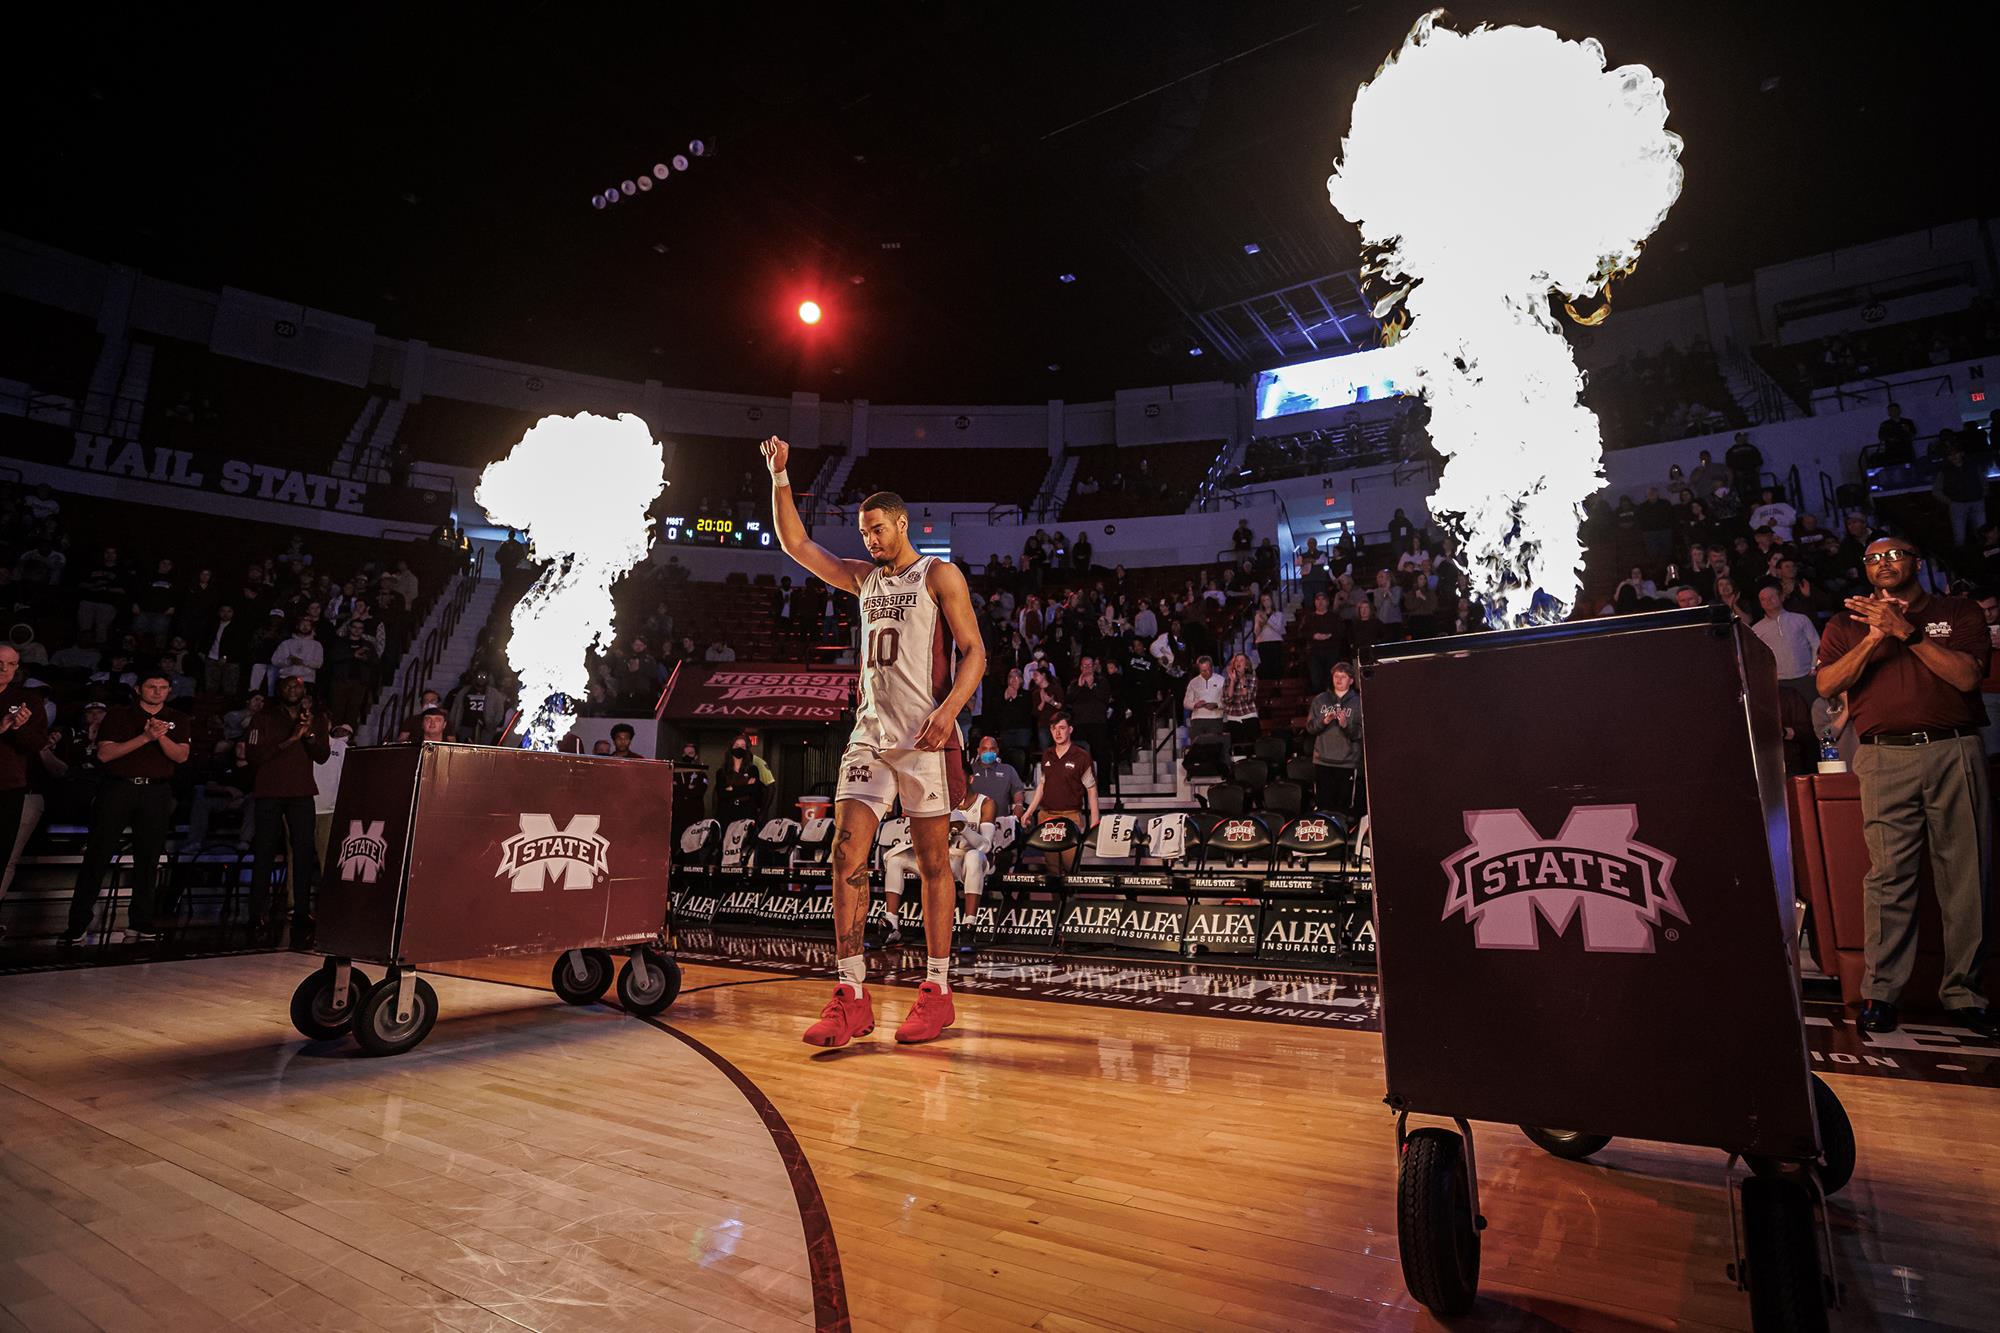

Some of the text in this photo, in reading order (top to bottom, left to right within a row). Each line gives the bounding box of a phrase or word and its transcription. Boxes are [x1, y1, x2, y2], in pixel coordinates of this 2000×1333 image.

[1969, 365, 1984, 379] N
[69, 431, 367, 513] HAIL STATE
[1322, 478, 1333, 488] M
[924, 507, 931, 517] L
[696, 518, 732, 532] 20:00
[668, 527, 677, 540] 0
[685, 528, 693, 538] 4
[734, 532, 742, 541] 4
[761, 532, 770, 546] 0
[863, 594, 917, 610] MISSISSIPPI
[872, 609, 897, 621] STATE
[867, 627, 900, 668] 10
[704, 674, 861, 686] MISSISSIP
[744, 687, 831, 697] STATE
[470, 701, 484, 711] 22
[692, 703, 838, 716] BANKFIRS
[805, 808, 815, 819] G
[347, 839, 379, 860] STATE
[522, 837, 591, 862] STATE
[1068, 876, 1104, 884] HAIL STATE
[1124, 877, 1140, 885] HAIL
[1482, 851, 1630, 897] STATE
[1196, 879, 1214, 887] HAIL
[1270, 880, 1312, 888] HAIL STATE
[682, 895, 716, 914] ALFA
[723, 892, 761, 908] ALFA
[760, 896, 799, 914] ALFA
[799, 896, 834, 913] ALF
[1000, 908, 1053, 928] ALFA
[1064, 906, 1120, 927] ALFA
[1120, 910, 1180, 934] ALFA
[997, 926, 1054, 936] INSURANCE
[1061, 925, 1117, 935] INSURANC
[1189, 914, 1255, 935] ALFA
[1117, 929, 1180, 942] INSURANCE
[1264, 920, 1336, 944] ALFA
[1261, 942, 1337, 954] INSURANCE
[1041, 988, 1163, 1005] LINCOLN
[1208, 1002, 1370, 1024] LOWNDES
